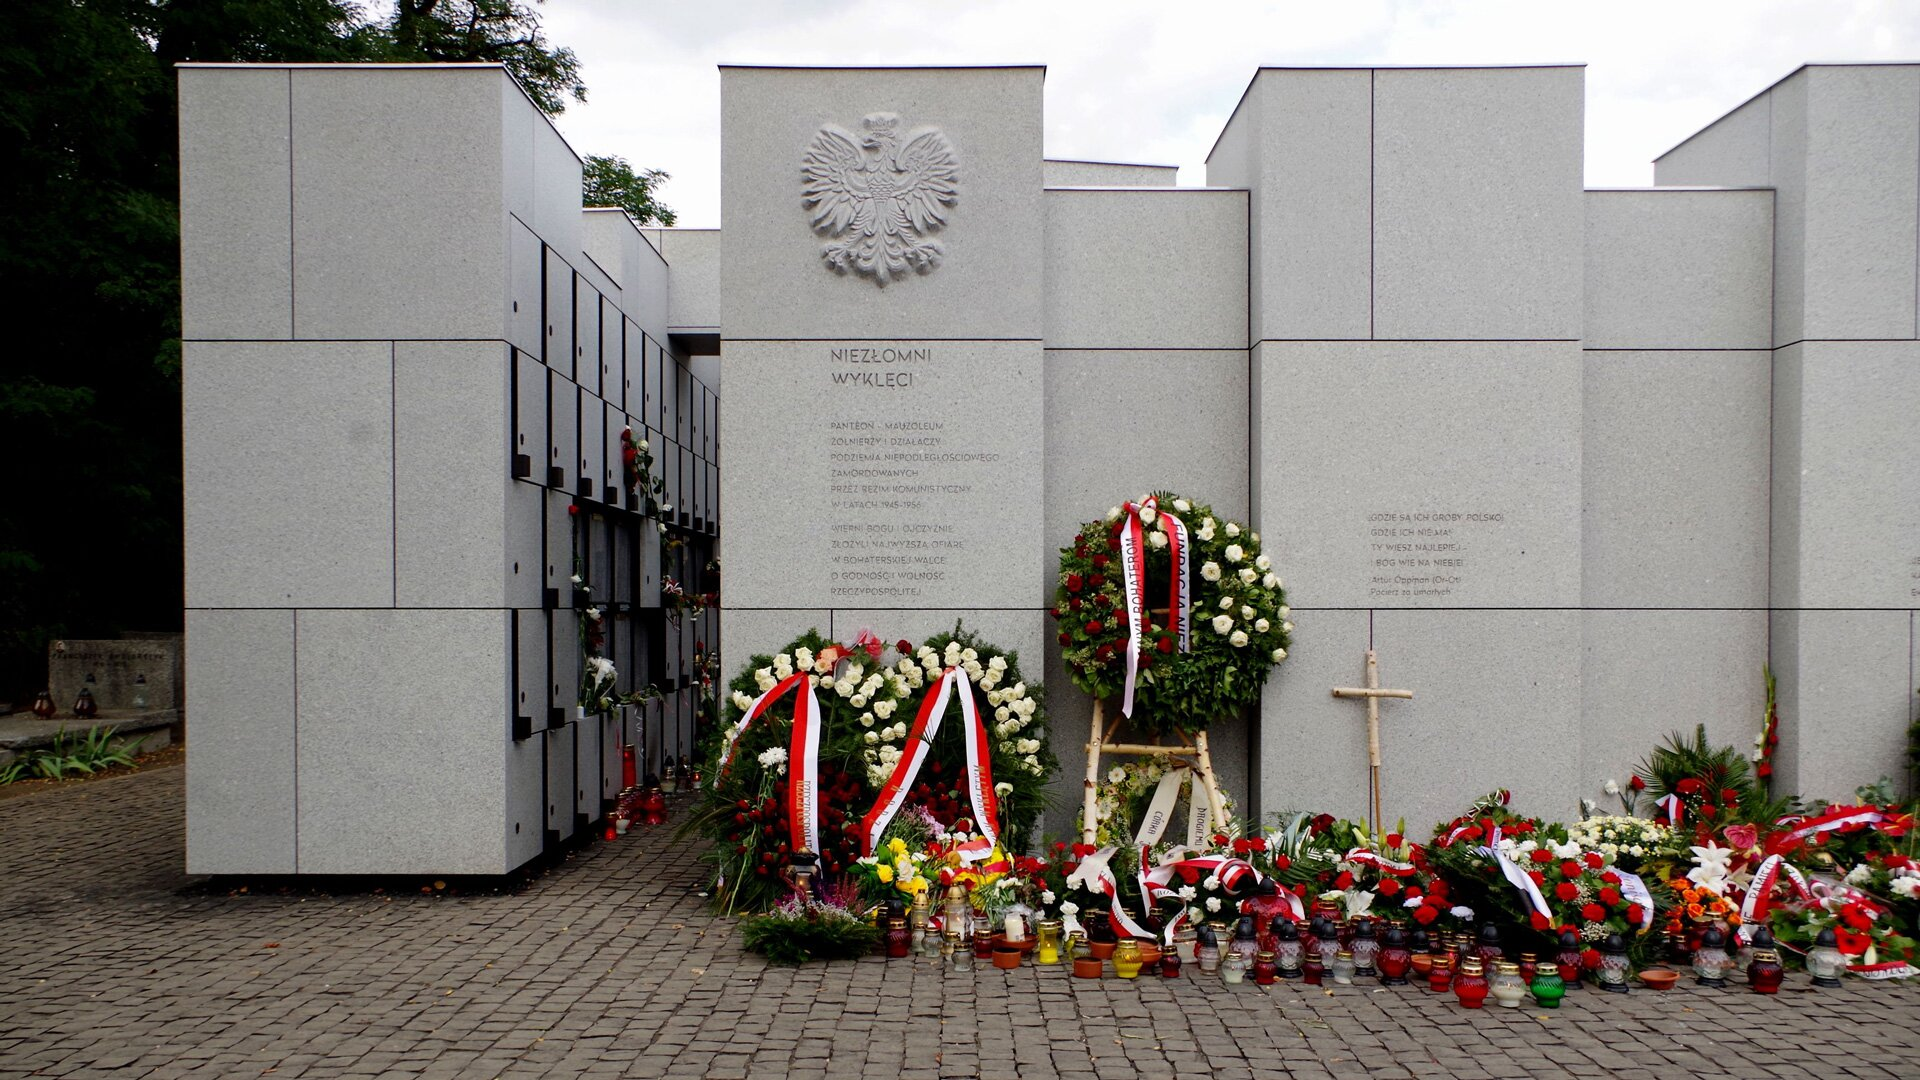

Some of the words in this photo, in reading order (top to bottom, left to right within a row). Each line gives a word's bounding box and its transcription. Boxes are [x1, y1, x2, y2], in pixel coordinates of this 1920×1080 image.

[831, 348, 931, 363] NIEZŁOMNI
[831, 372, 913, 390] WYKLĘCI
[830, 422, 874, 431] PANTEON
[885, 422, 943, 431] MAUZOLEUM
[891, 437, 941, 446] DZIAŁACZY
[830, 453, 881, 462] PODZIEMIA
[831, 469, 919, 478] ZAMORDOWANYCH
[830, 485, 858, 494] PRZEZ
[892, 485, 972, 494] KOMUNISTYCZNY
[831, 501, 841, 509] W
[844, 501, 878, 510] LATACH
[1414, 513, 1430, 521] ICH
[831, 525, 863, 533] WIERNI
[867, 525, 894, 533] BOGU
[1371, 528, 1397, 537] GDZIE
[1400, 528, 1414, 537] ICH
[1417, 528, 1432, 537] NIE
[831, 556, 841, 565] W
[844, 556, 911, 565] BOHATERSKIEJ
[914, 556, 945, 565] WALCE
[1399, 559, 1415, 567] WIE
[1418, 559, 1430, 567] NA
[831, 572, 838, 580] O
[1125, 536, 1142, 614] BOHATEROM
[830, 587, 921, 597] RZECZYPOSPOLITEJ
